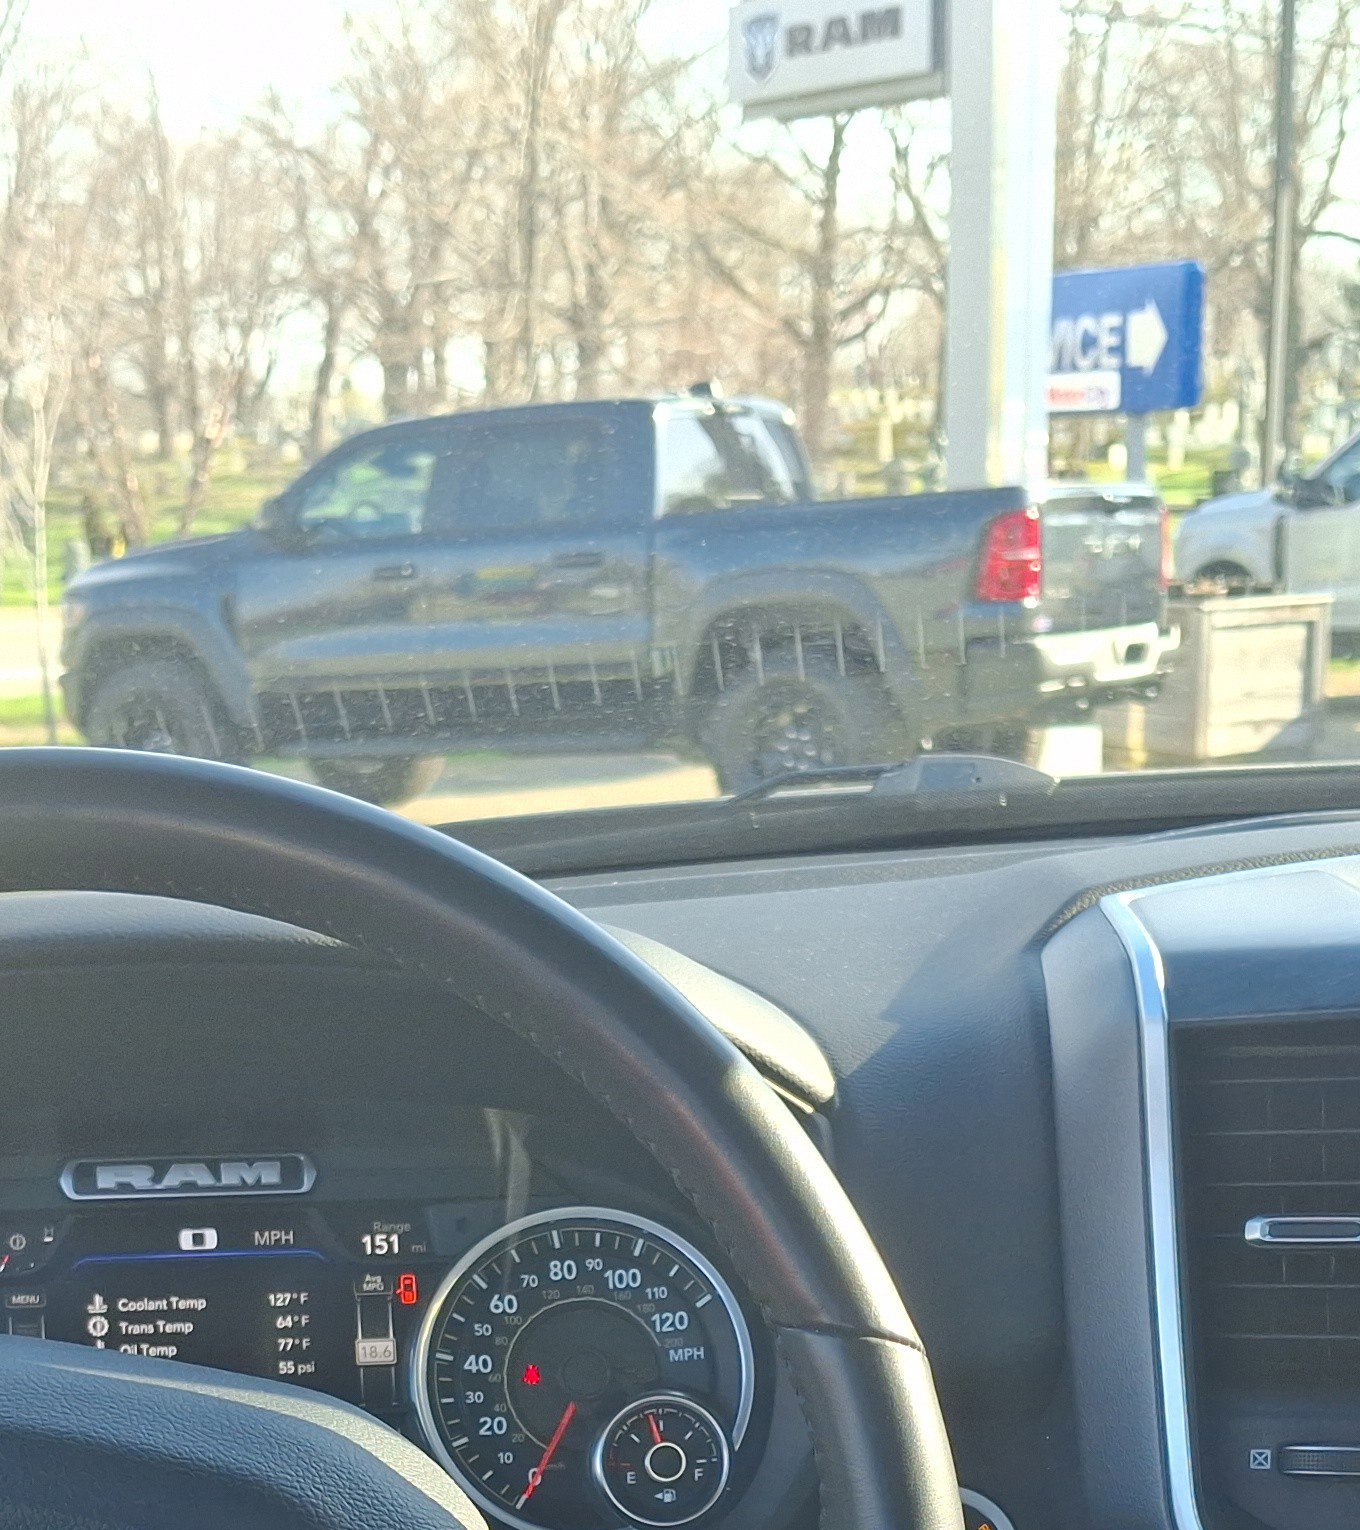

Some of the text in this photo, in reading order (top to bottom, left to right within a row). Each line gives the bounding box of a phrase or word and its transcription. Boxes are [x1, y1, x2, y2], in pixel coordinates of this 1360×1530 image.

[785, 6, 905, 59] RAM
[95, 1161, 283, 1190] RAM
[373, 1221, 412, 1234] Range
[254, 1230, 295, 1246] MPH
[361, 1233, 401, 1255] 151
[549, 1259, 578, 1281] 80
[585, 1257, 604, 1271] 90
[520, 1274, 539, 1288] 70
[604, 1267, 642, 1290] 100
[11, 1294, 40, 1305] MENU
[645, 1285, 668, 1300] 110
[117, 1297, 168, 1312] Coolant
[169, 1296, 207, 1311] Temp
[489, 1293, 519, 1315] 60
[119, 1321, 154, 1336] Trans
[156, 1320, 194, 1335] Temp
[651, 1310, 689, 1333] 120
[473, 1323, 492, 1337] 50
[119, 1343, 137, 1357] Oil
[140, 1344, 178, 1358] Temp
[361, 1345, 392, 1358] 18.6
[669, 1346, 706, 1364] MPH
[278, 1361, 316, 1376] 55 psi
[463, 1354, 493, 1375] 40
[465, 1391, 484, 1405] 30
[479, 1416, 507, 1436] 20
[497, 1452, 515, 1465] 10
[626, 1471, 637, 1485] E
[694, 1468, 704, 1482] F
